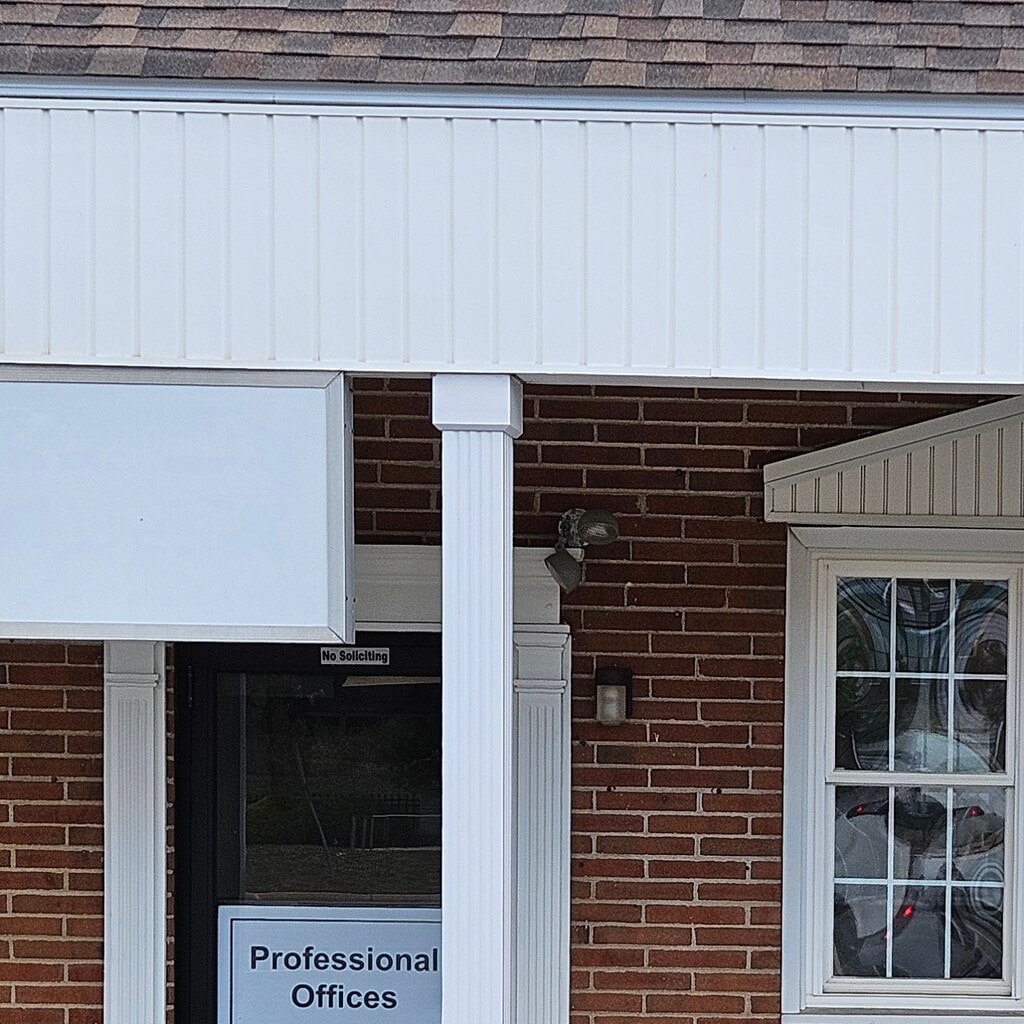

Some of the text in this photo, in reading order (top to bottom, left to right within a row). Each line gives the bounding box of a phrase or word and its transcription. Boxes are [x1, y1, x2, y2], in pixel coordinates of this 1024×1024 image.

[322, 650, 388, 664] No Soliciting
[250, 945, 439, 972] Professional
[291, 983, 398, 1009] Offices
